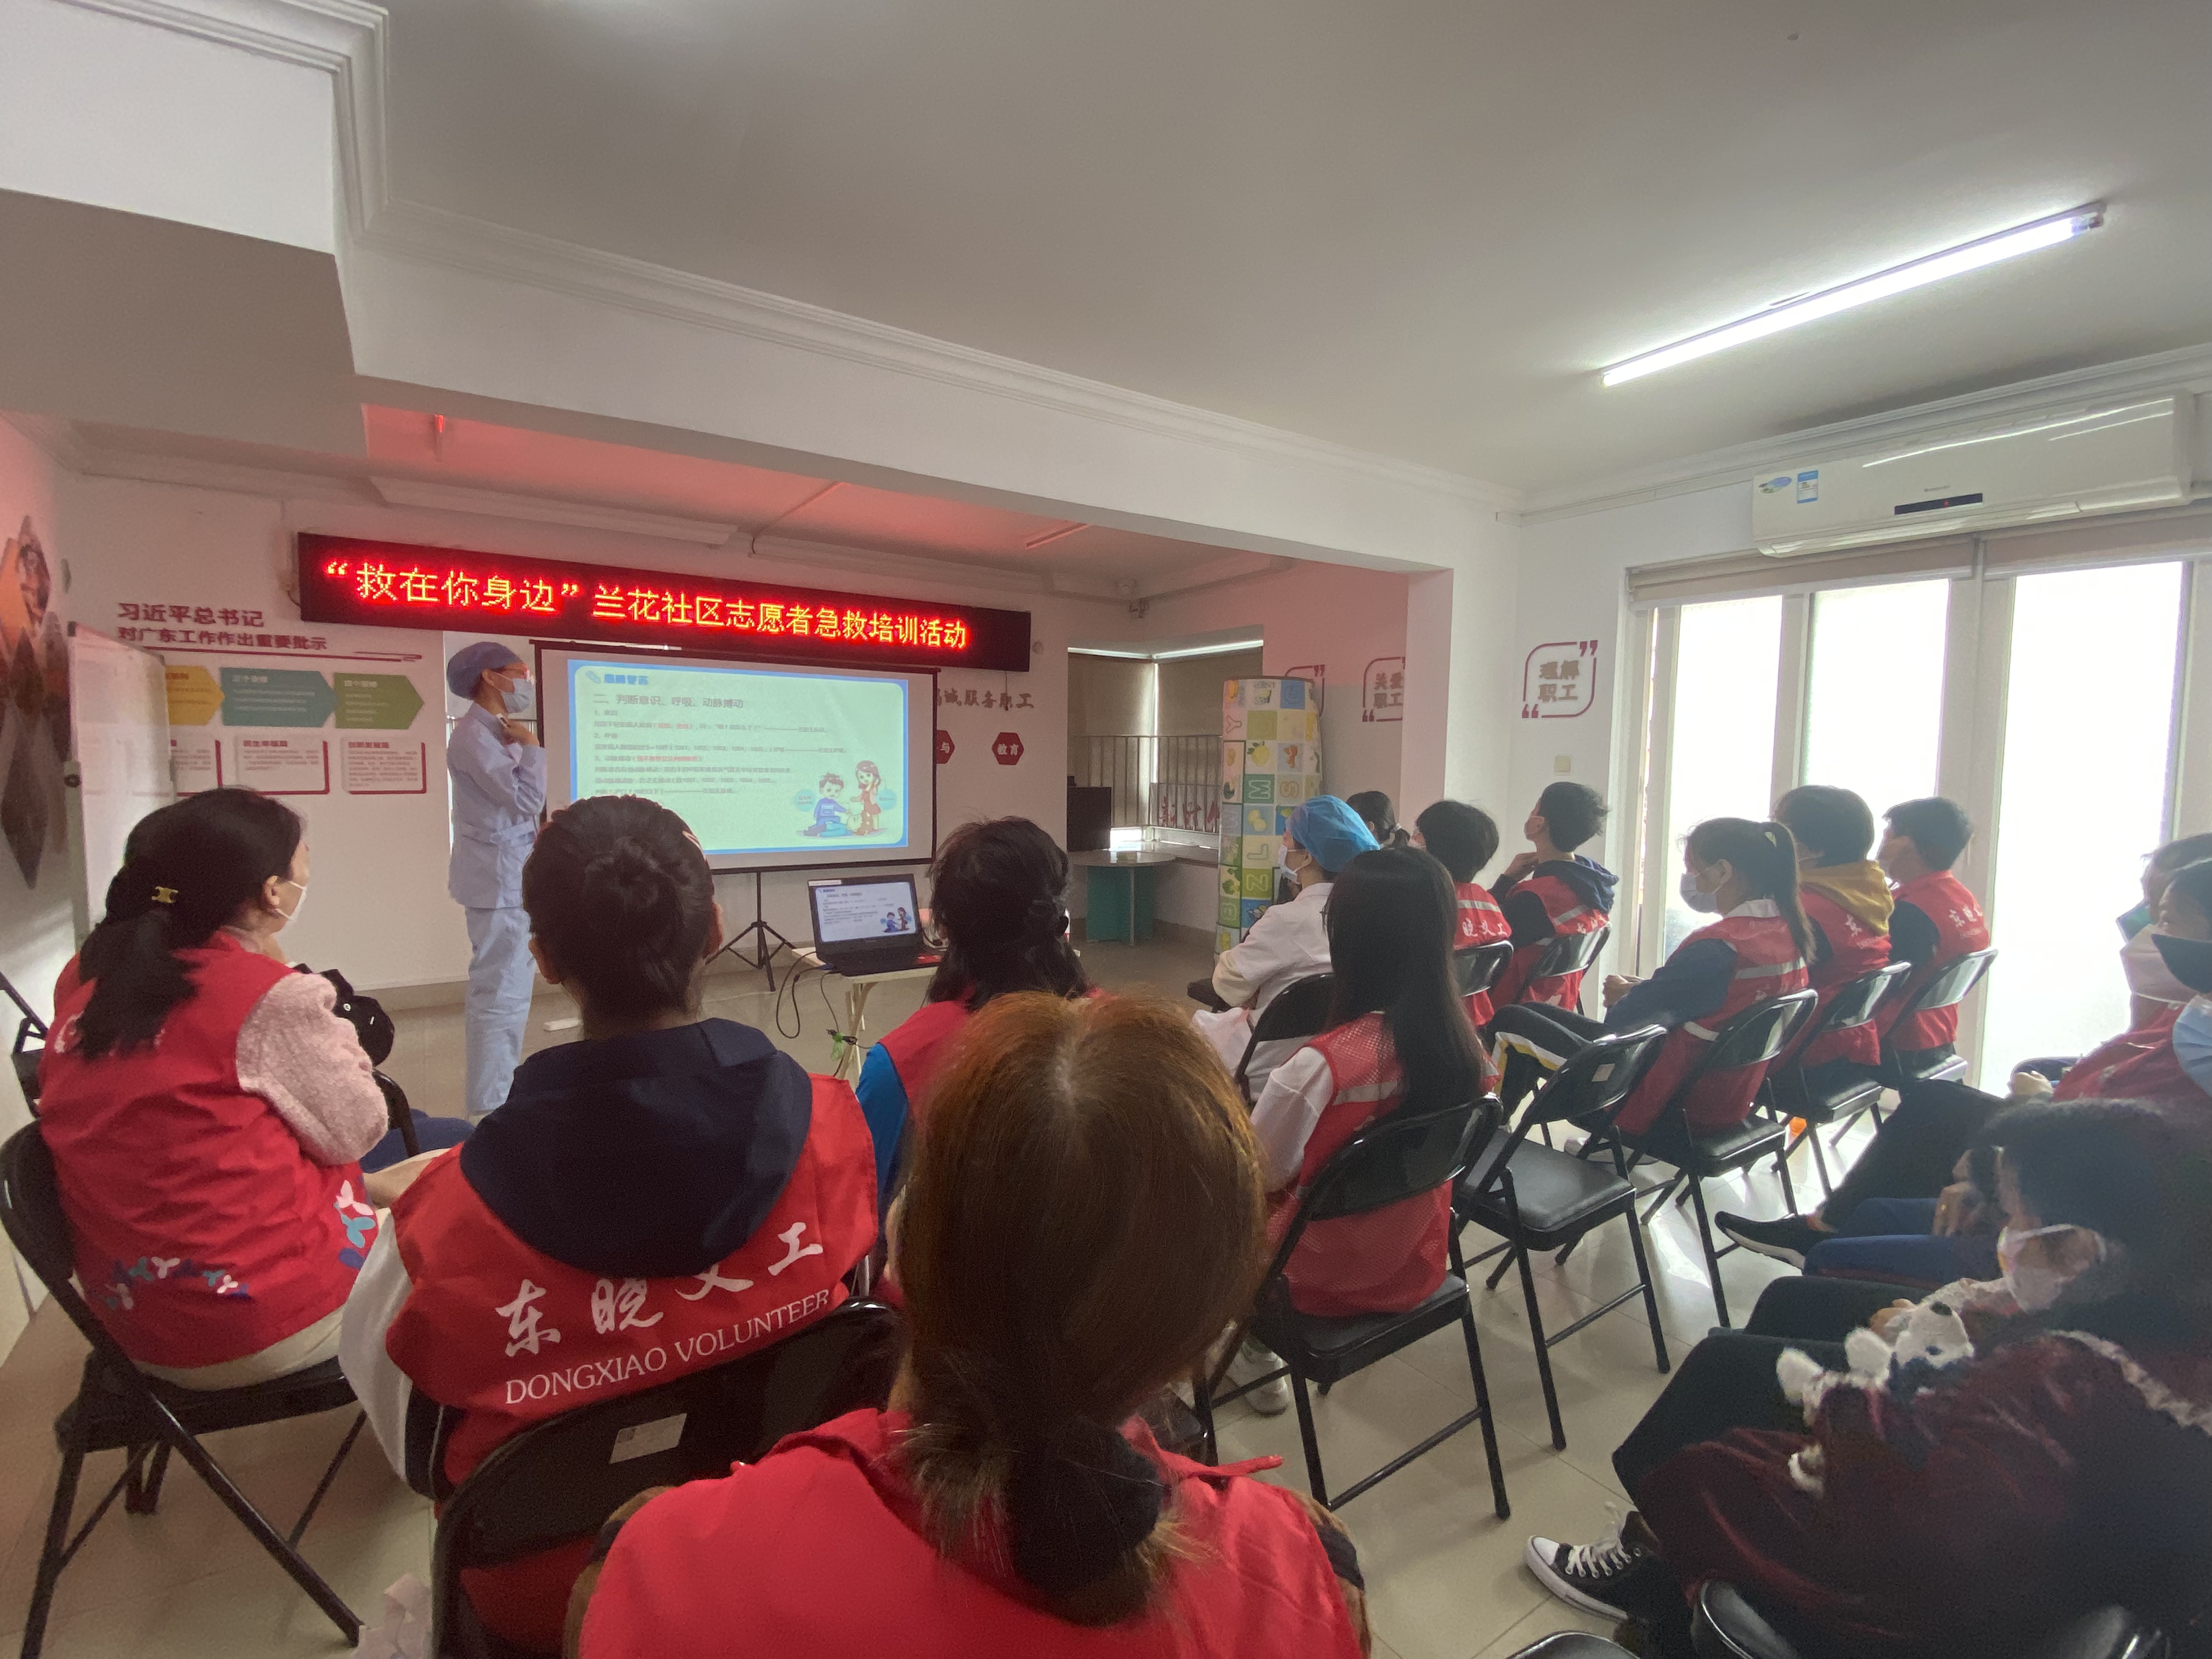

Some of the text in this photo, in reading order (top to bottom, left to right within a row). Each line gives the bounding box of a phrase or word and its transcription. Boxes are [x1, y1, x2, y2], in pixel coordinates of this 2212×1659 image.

[117, 602, 264, 628] 习近平总书记
[116, 627, 328, 650] 对广东工作作出重要批示
[505, 1289, 830, 1405] DONGXIAO VOLUNTEER
